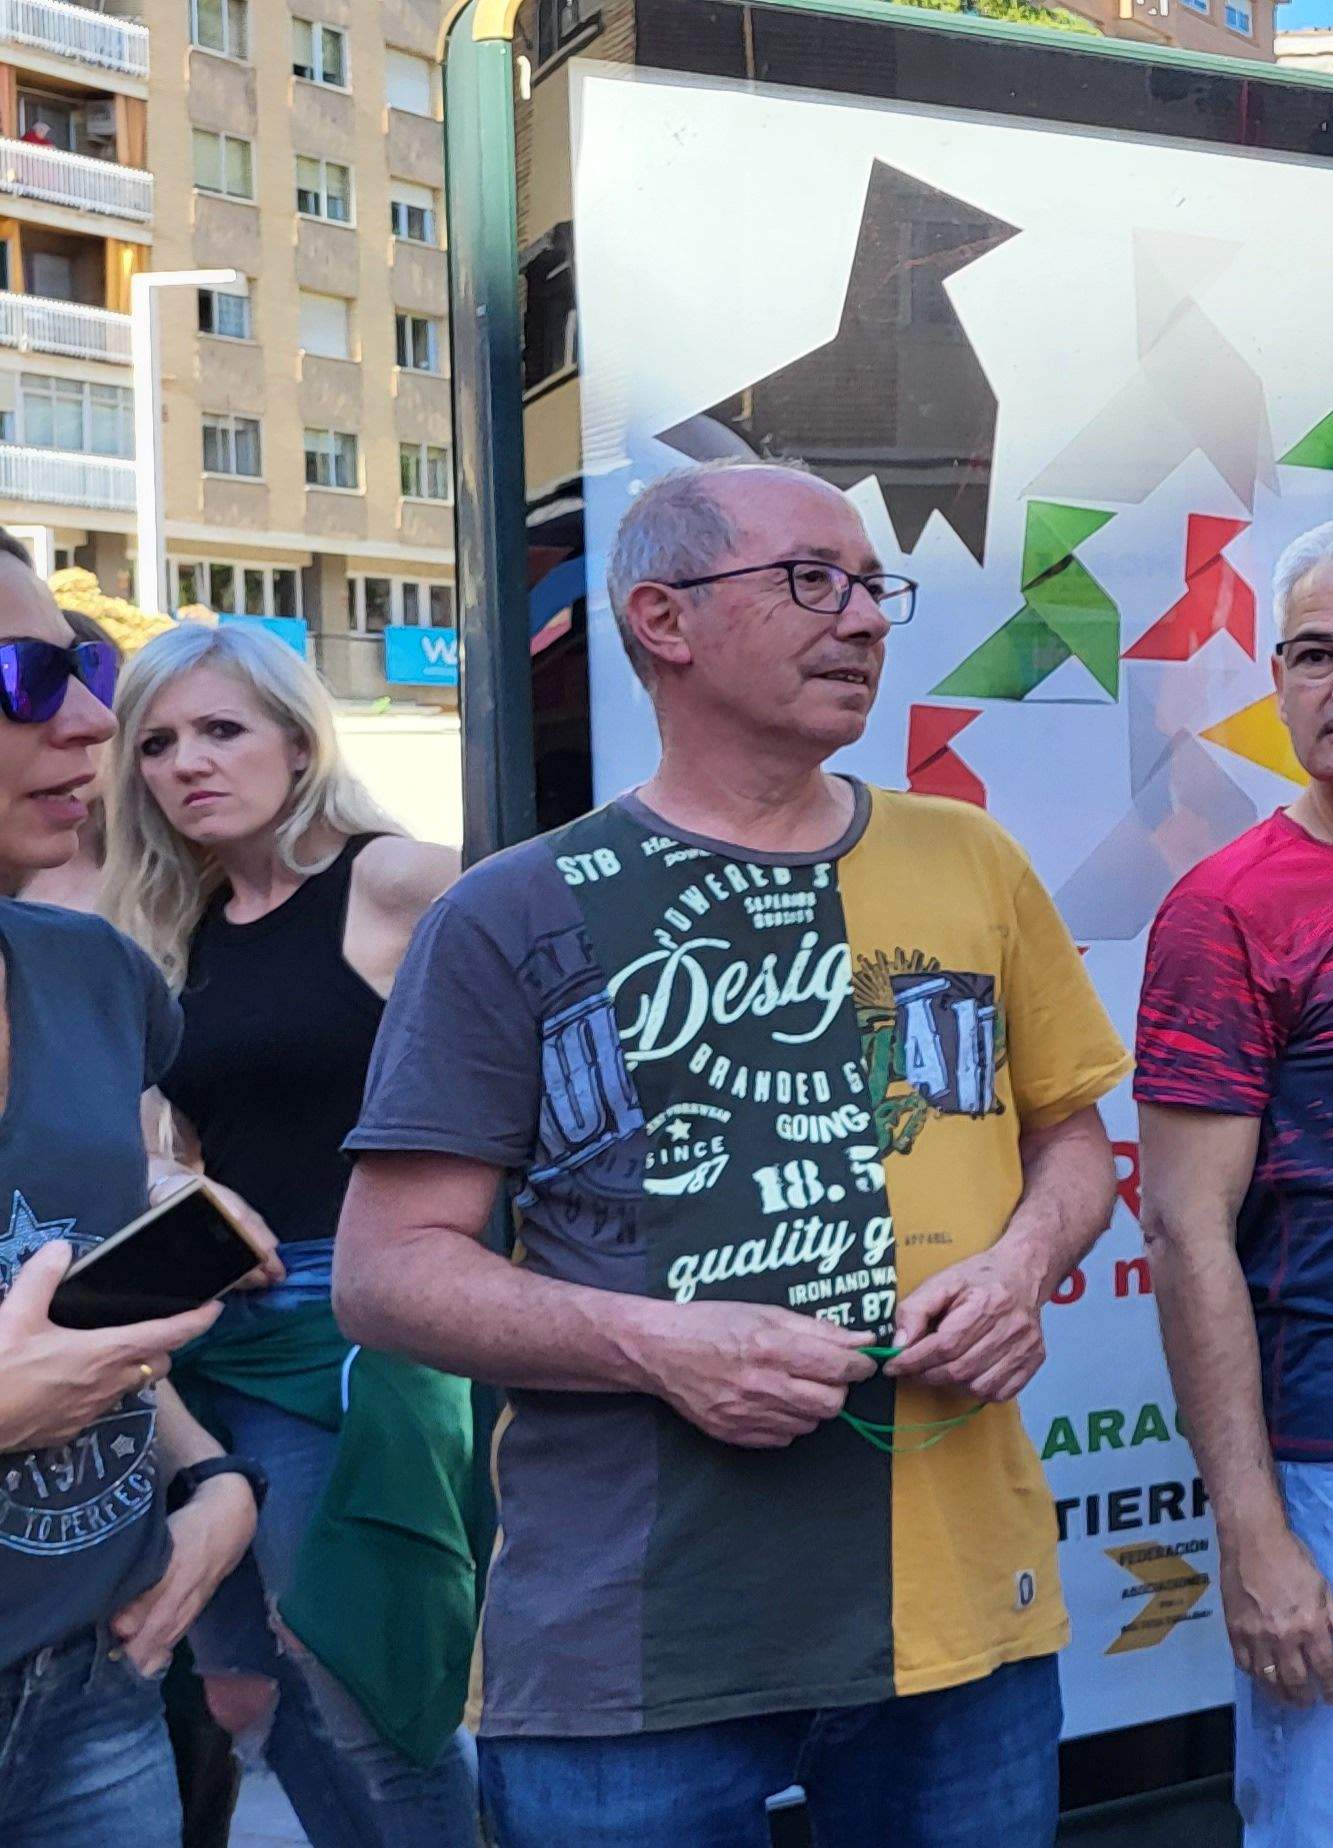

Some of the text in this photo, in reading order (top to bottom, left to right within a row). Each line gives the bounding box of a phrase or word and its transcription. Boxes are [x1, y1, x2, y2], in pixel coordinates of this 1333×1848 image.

[556, 848, 621, 885] STB
[606, 931, 855, 1061] Desig
[688, 1042, 831, 1105] BRANDED
[776, 1103, 871, 1143] GOING
[645, 1135, 725, 1170] SINCE
[667, 1215, 857, 1305] quality
[787, 1280, 833, 1307] IRON
[834, 1269, 870, 1296] AND
[862, 1289, 896, 1323] 87
[1040, 1403, 1187, 1461] ARA
